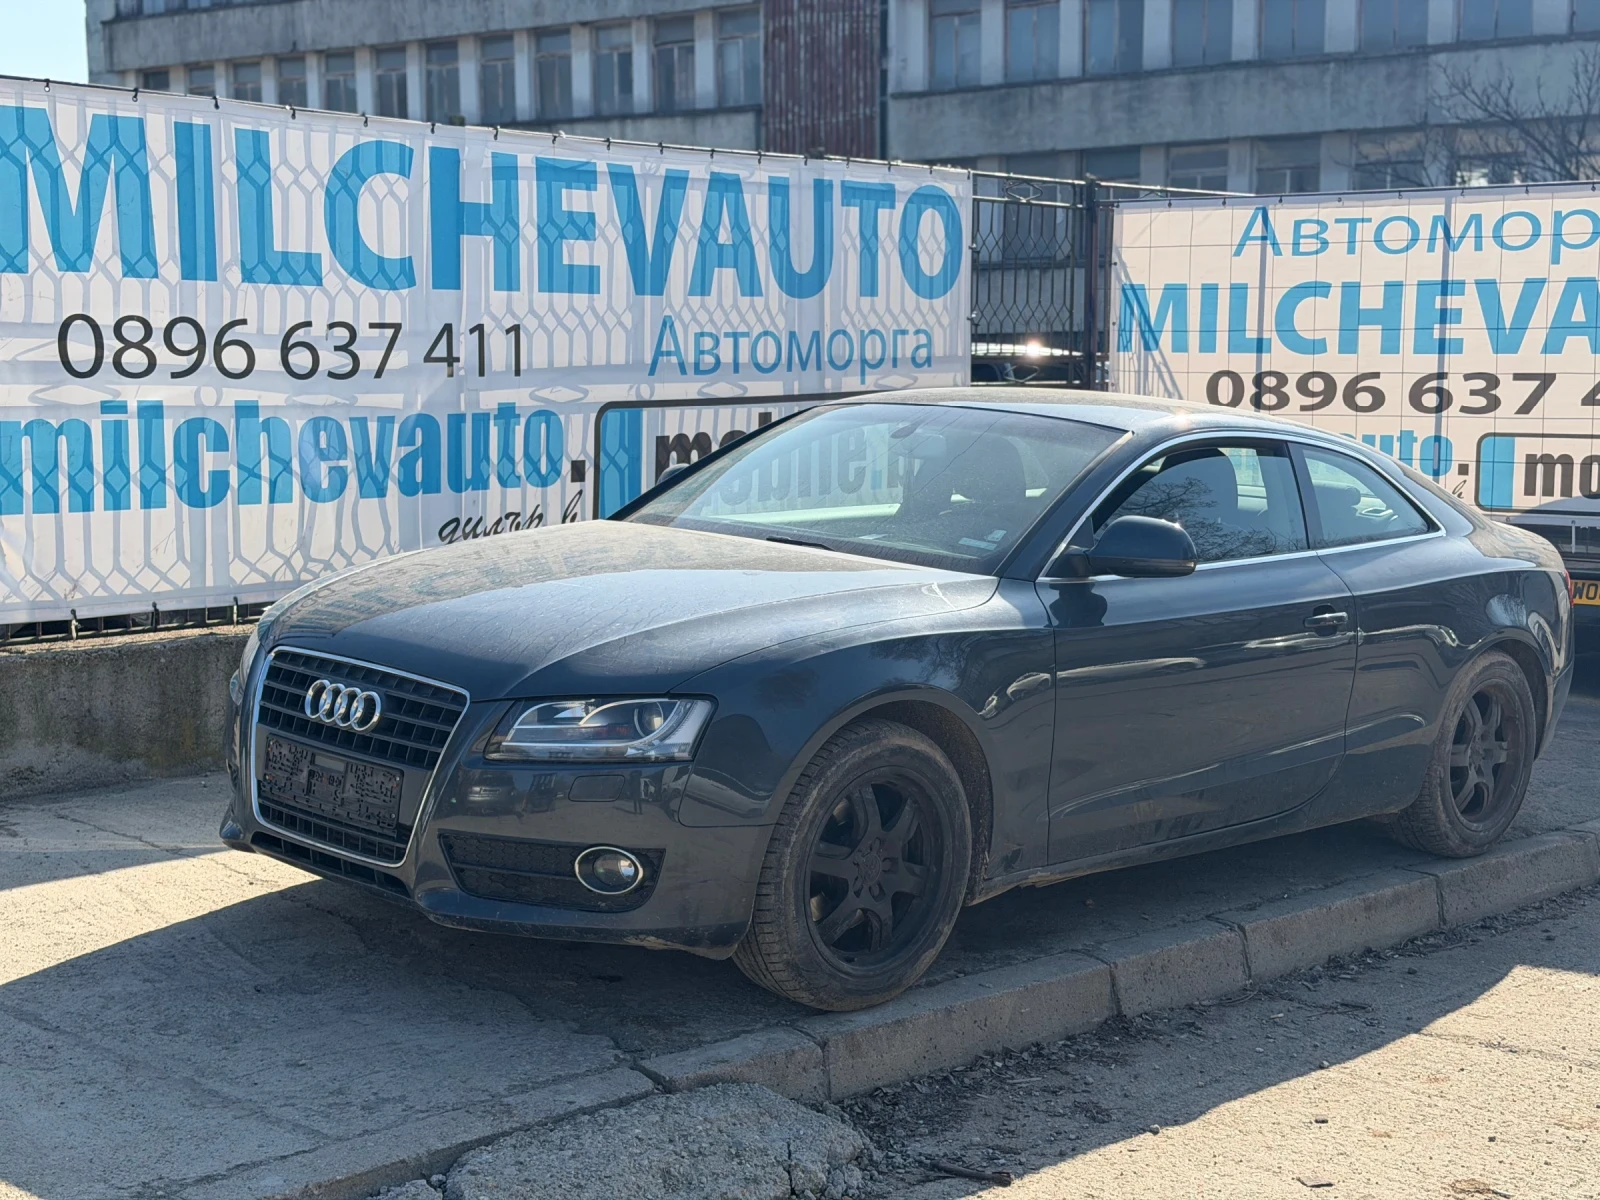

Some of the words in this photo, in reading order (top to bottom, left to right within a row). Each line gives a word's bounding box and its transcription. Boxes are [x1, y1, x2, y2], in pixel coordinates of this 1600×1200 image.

[0, 106, 963, 301] MILCHEVAUTO
[1232, 206, 1600, 266] Автомор
[57, 313, 256, 379] 0896
[280, 319, 403, 379] 637
[423, 322, 521, 378] 411
[647, 315, 933, 385] Автоморга
[1117, 276, 1600, 356] MILCHEVA
[1206, 369, 1386, 414] 0896
[1408, 372, 1557, 415] 637
